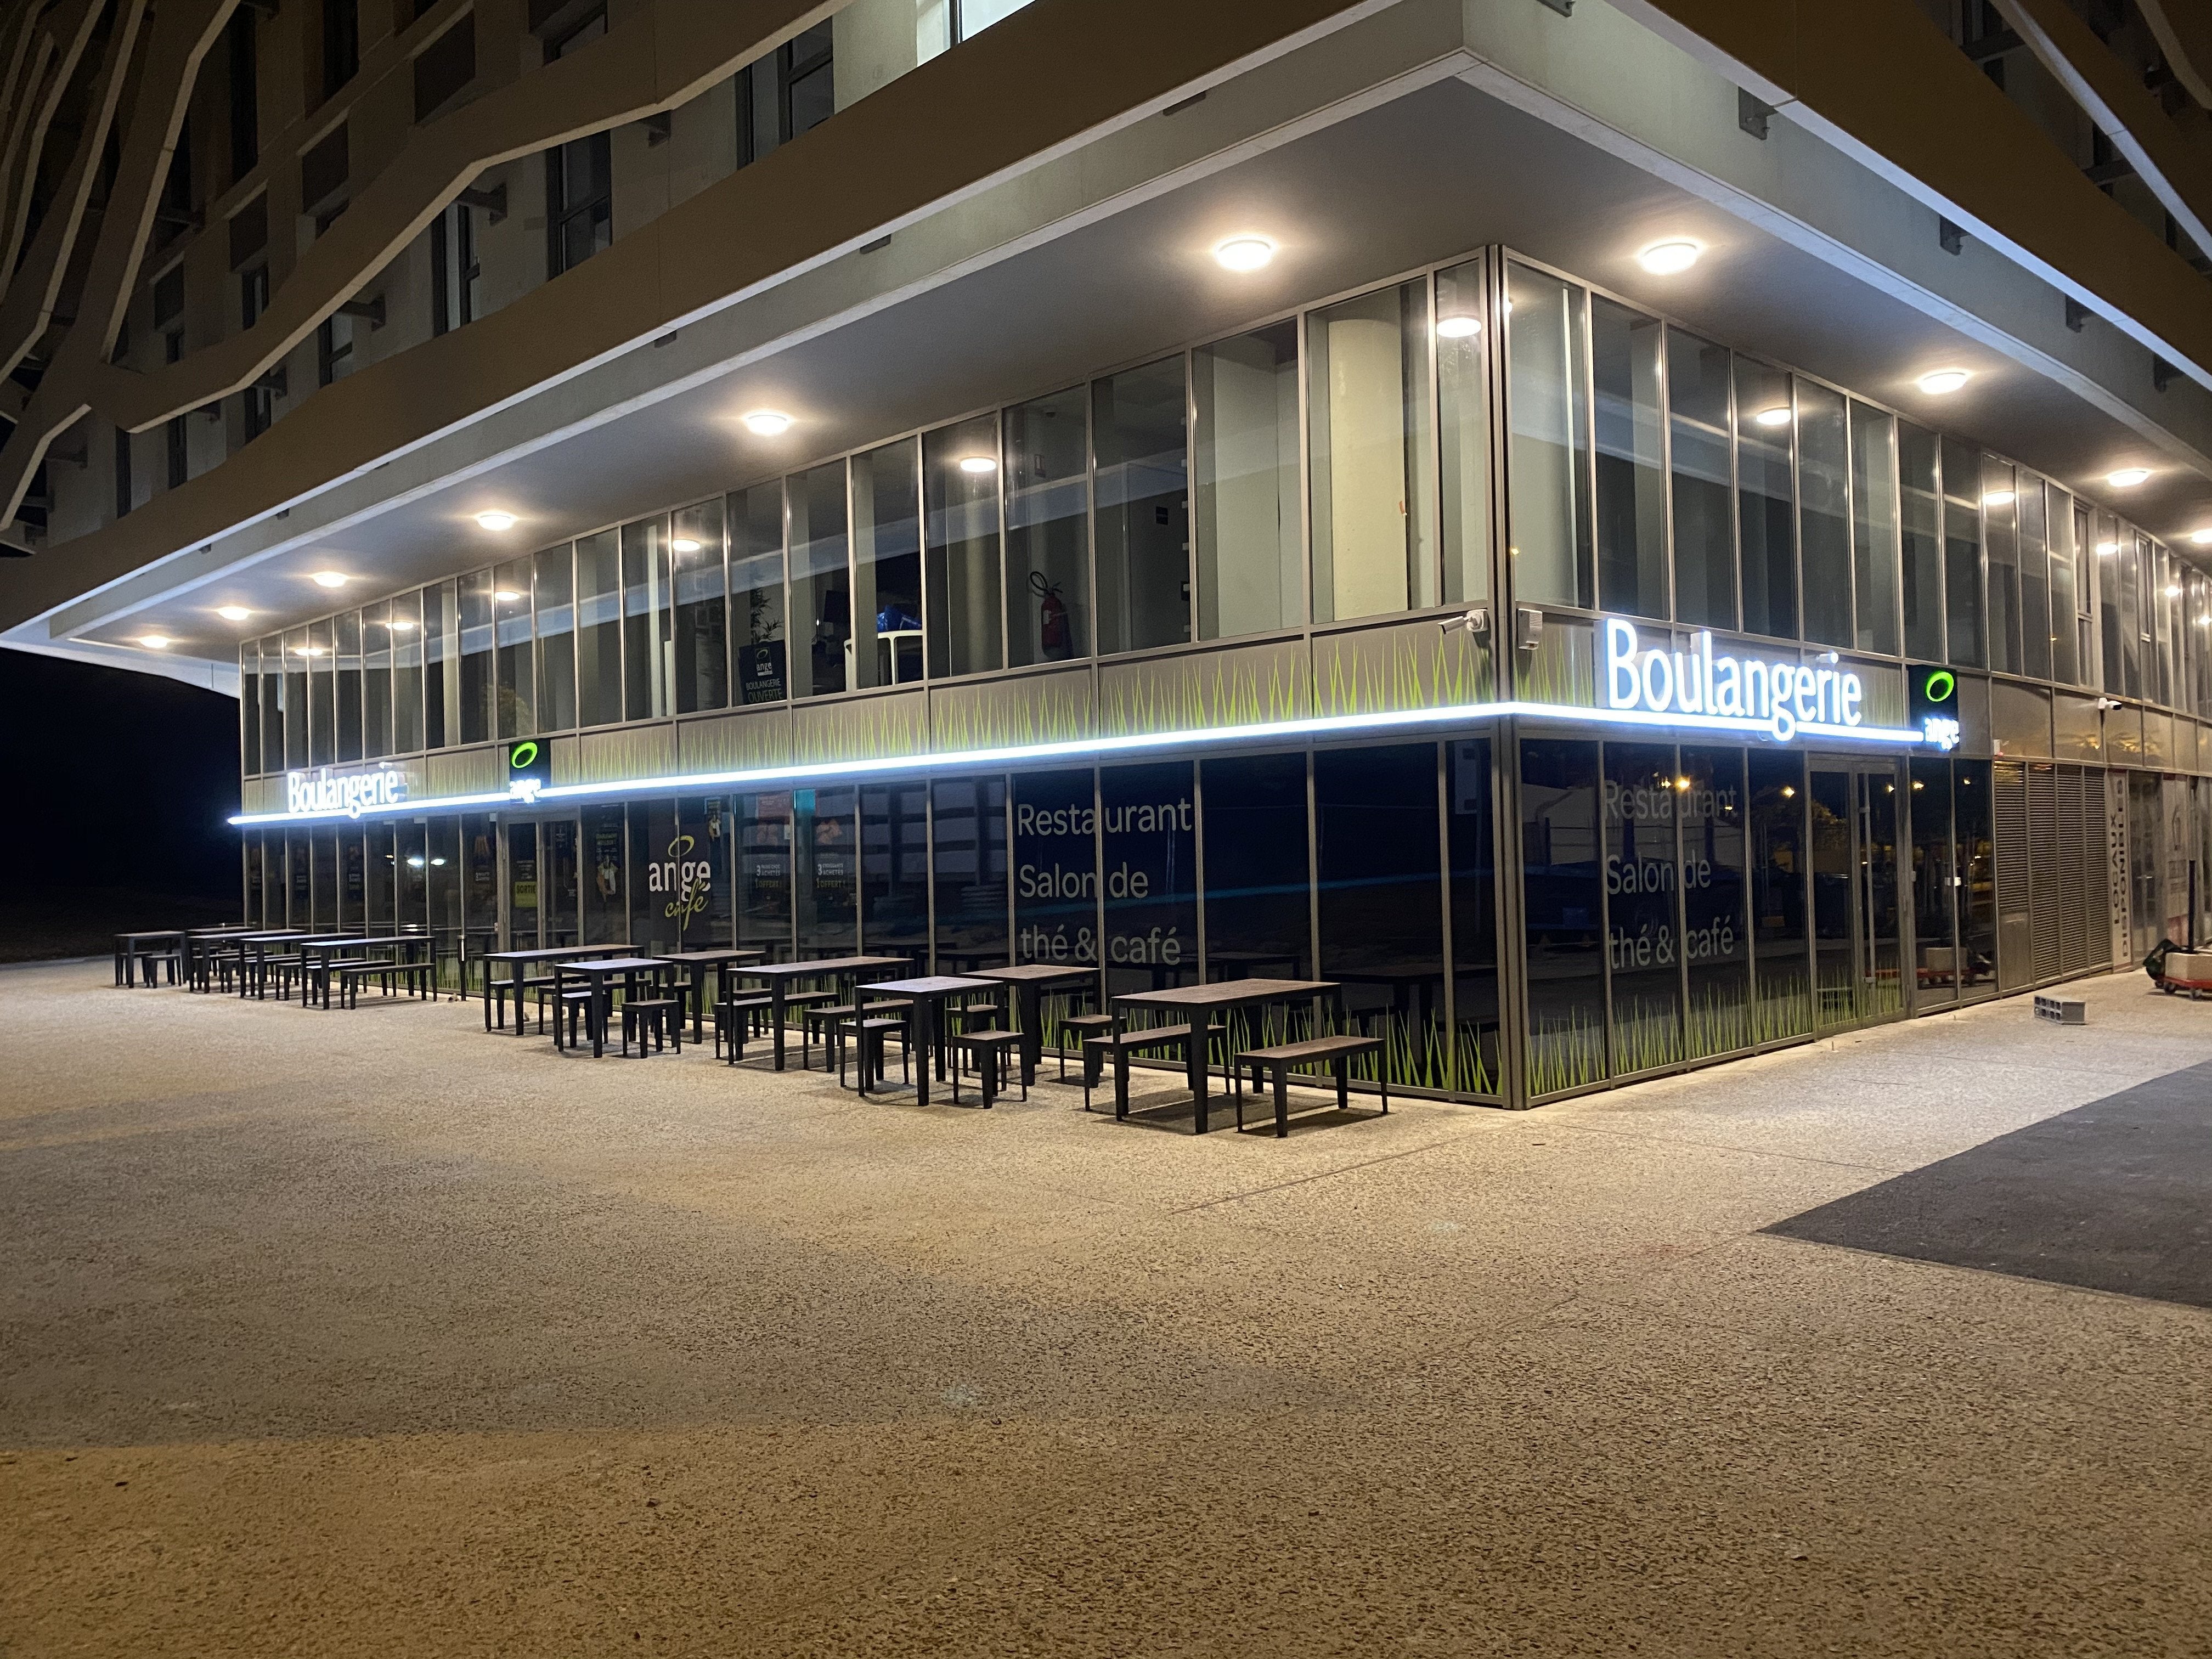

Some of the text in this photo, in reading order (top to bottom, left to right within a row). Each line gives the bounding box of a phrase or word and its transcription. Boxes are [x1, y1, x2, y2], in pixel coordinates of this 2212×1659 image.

[746, 678, 781, 691] BOULANGERIE
[757, 662, 772, 673] ange
[1606, 617, 1862, 742] Boulangerie
[748, 688, 783, 703] OUVERTE
[288, 761, 399, 819] Boulangerie
[1604, 779, 1739, 820] Restaurant
[1017, 797, 1192, 837] Restaurant
[516, 884, 537, 894] SORTIE
[648, 861, 711, 902] ange
[817, 864, 823, 876] 3
[1019, 861, 1149, 899] Salon de
[1606, 849, 1712, 895] Salon de
[664, 877, 709, 931] café
[1020, 923, 1182, 966] thé & café
[1608, 915, 1735, 970] thé & café
